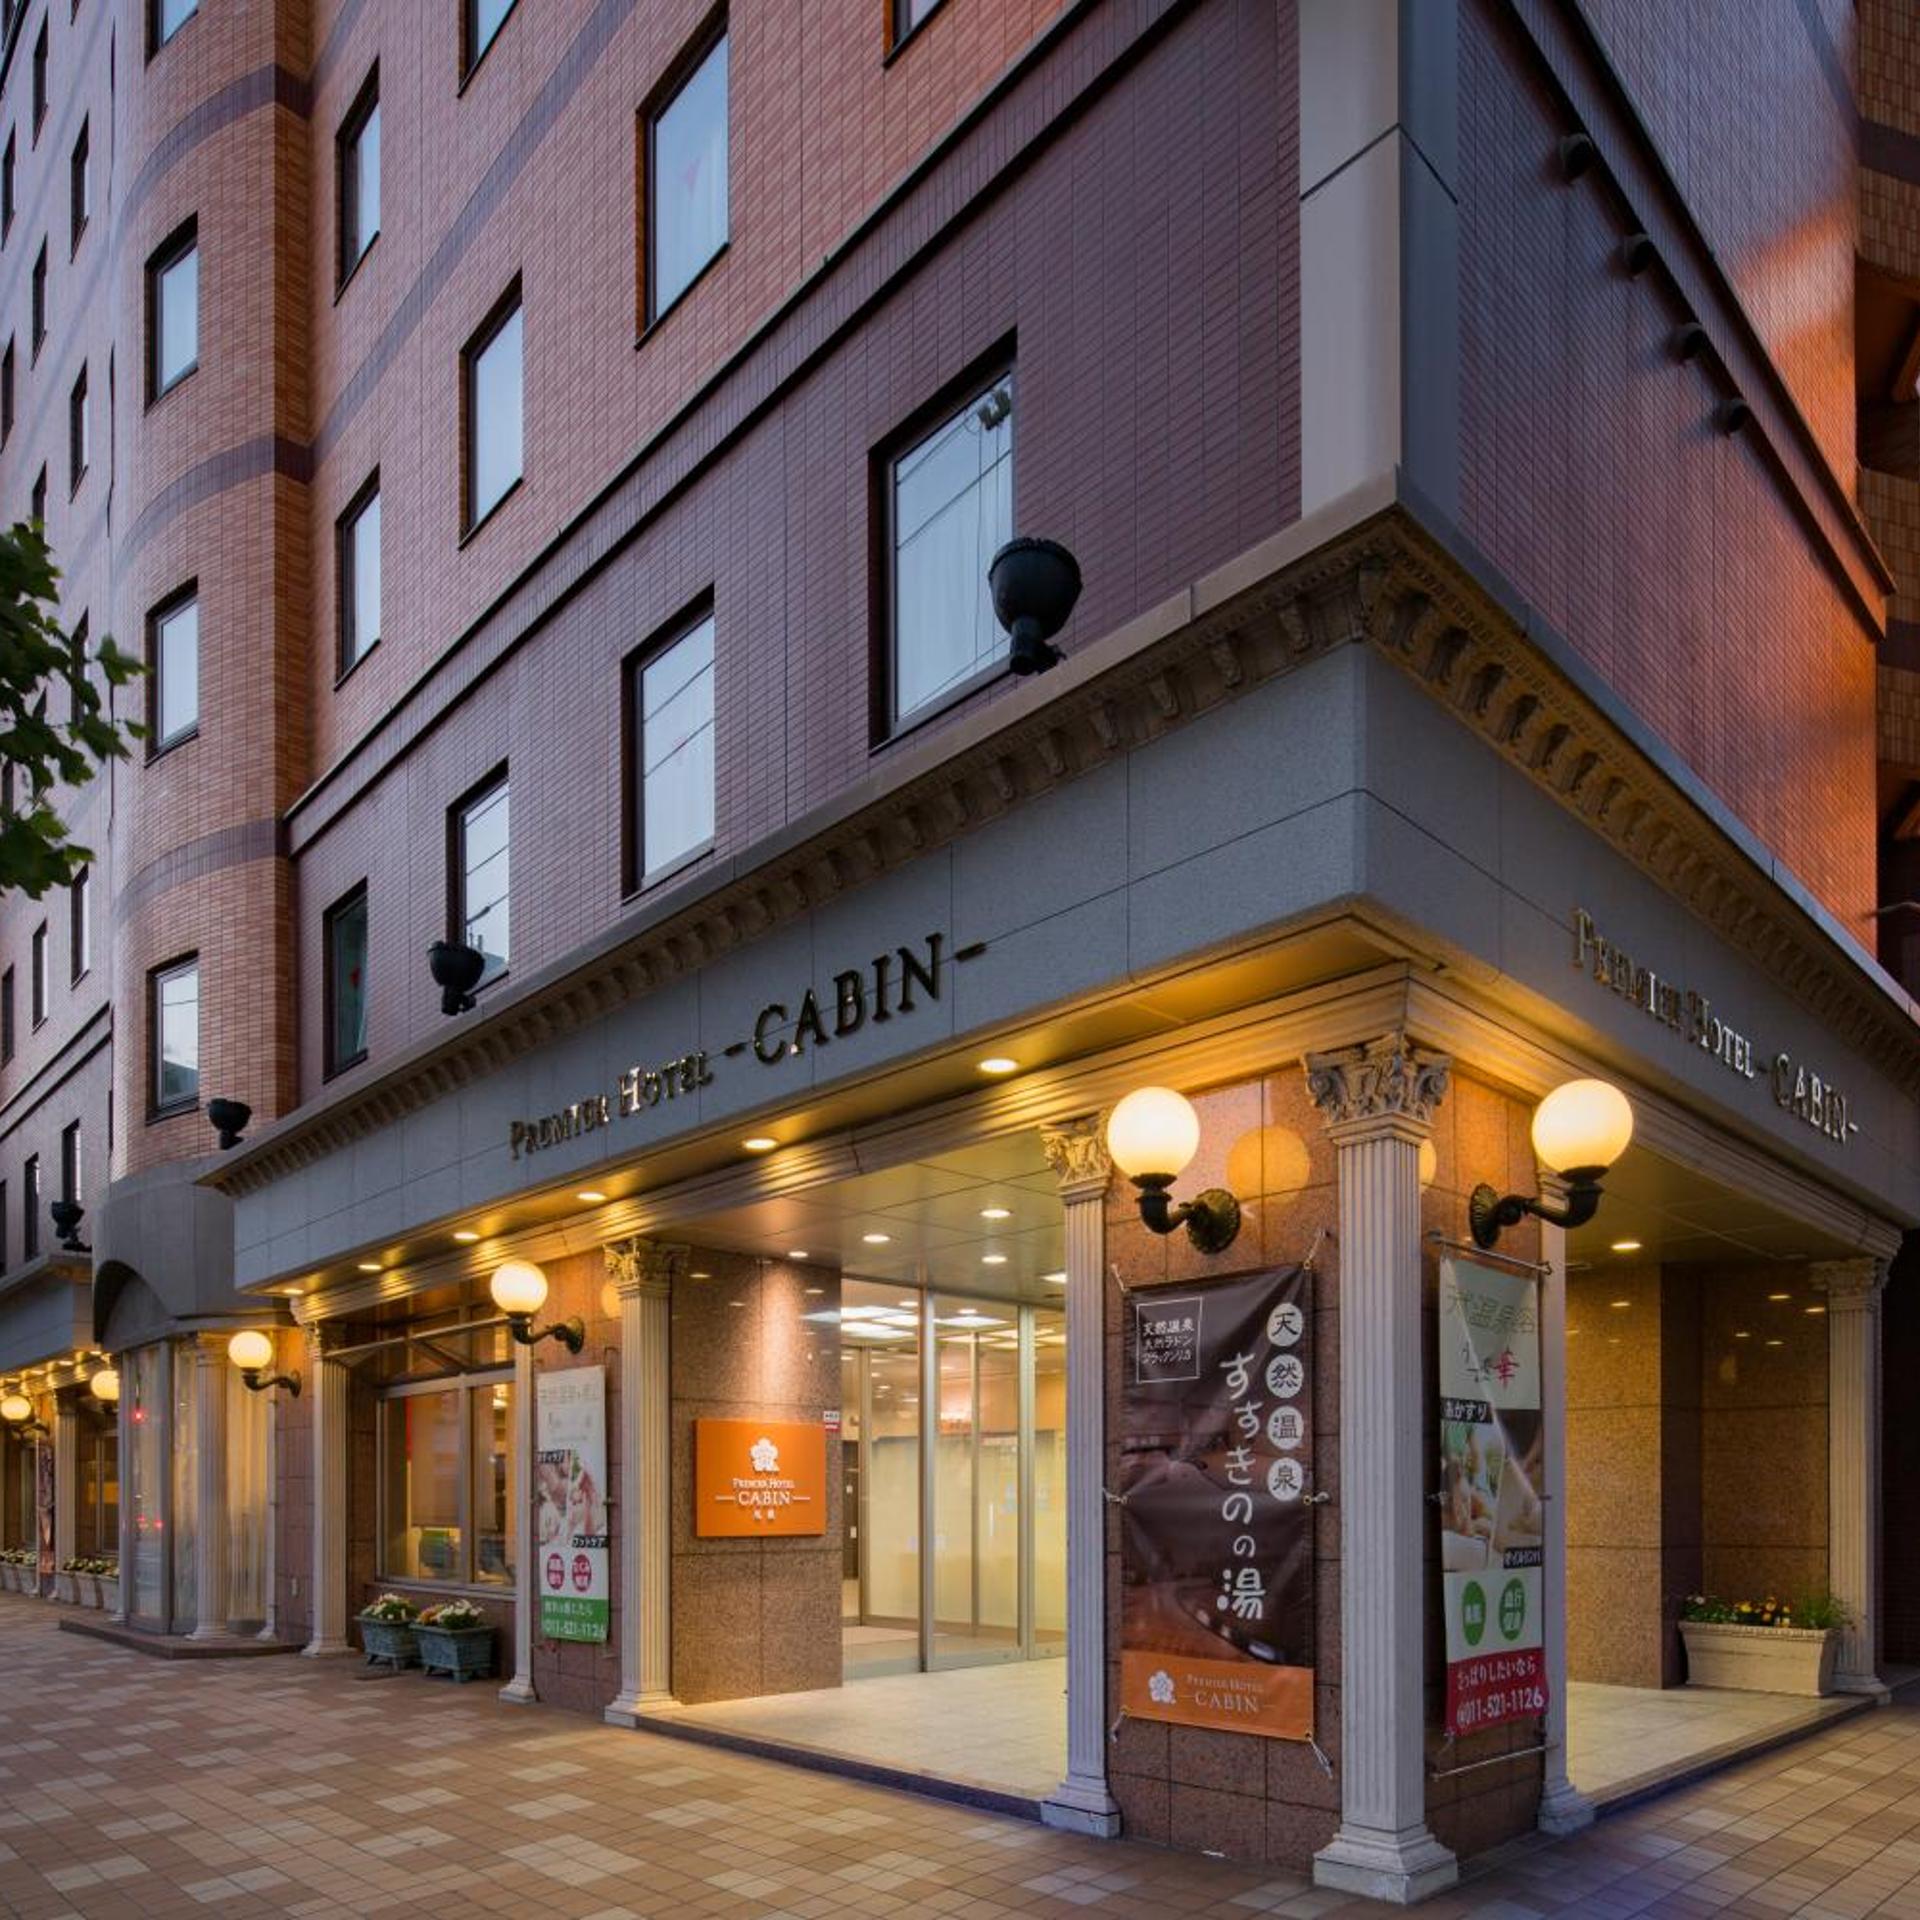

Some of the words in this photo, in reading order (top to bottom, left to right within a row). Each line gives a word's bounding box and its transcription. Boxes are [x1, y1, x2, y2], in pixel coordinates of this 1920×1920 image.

[618, 1051, 714, 1118] HOTEL
[1269, 1308, 1301, 1494] 天然温泉
